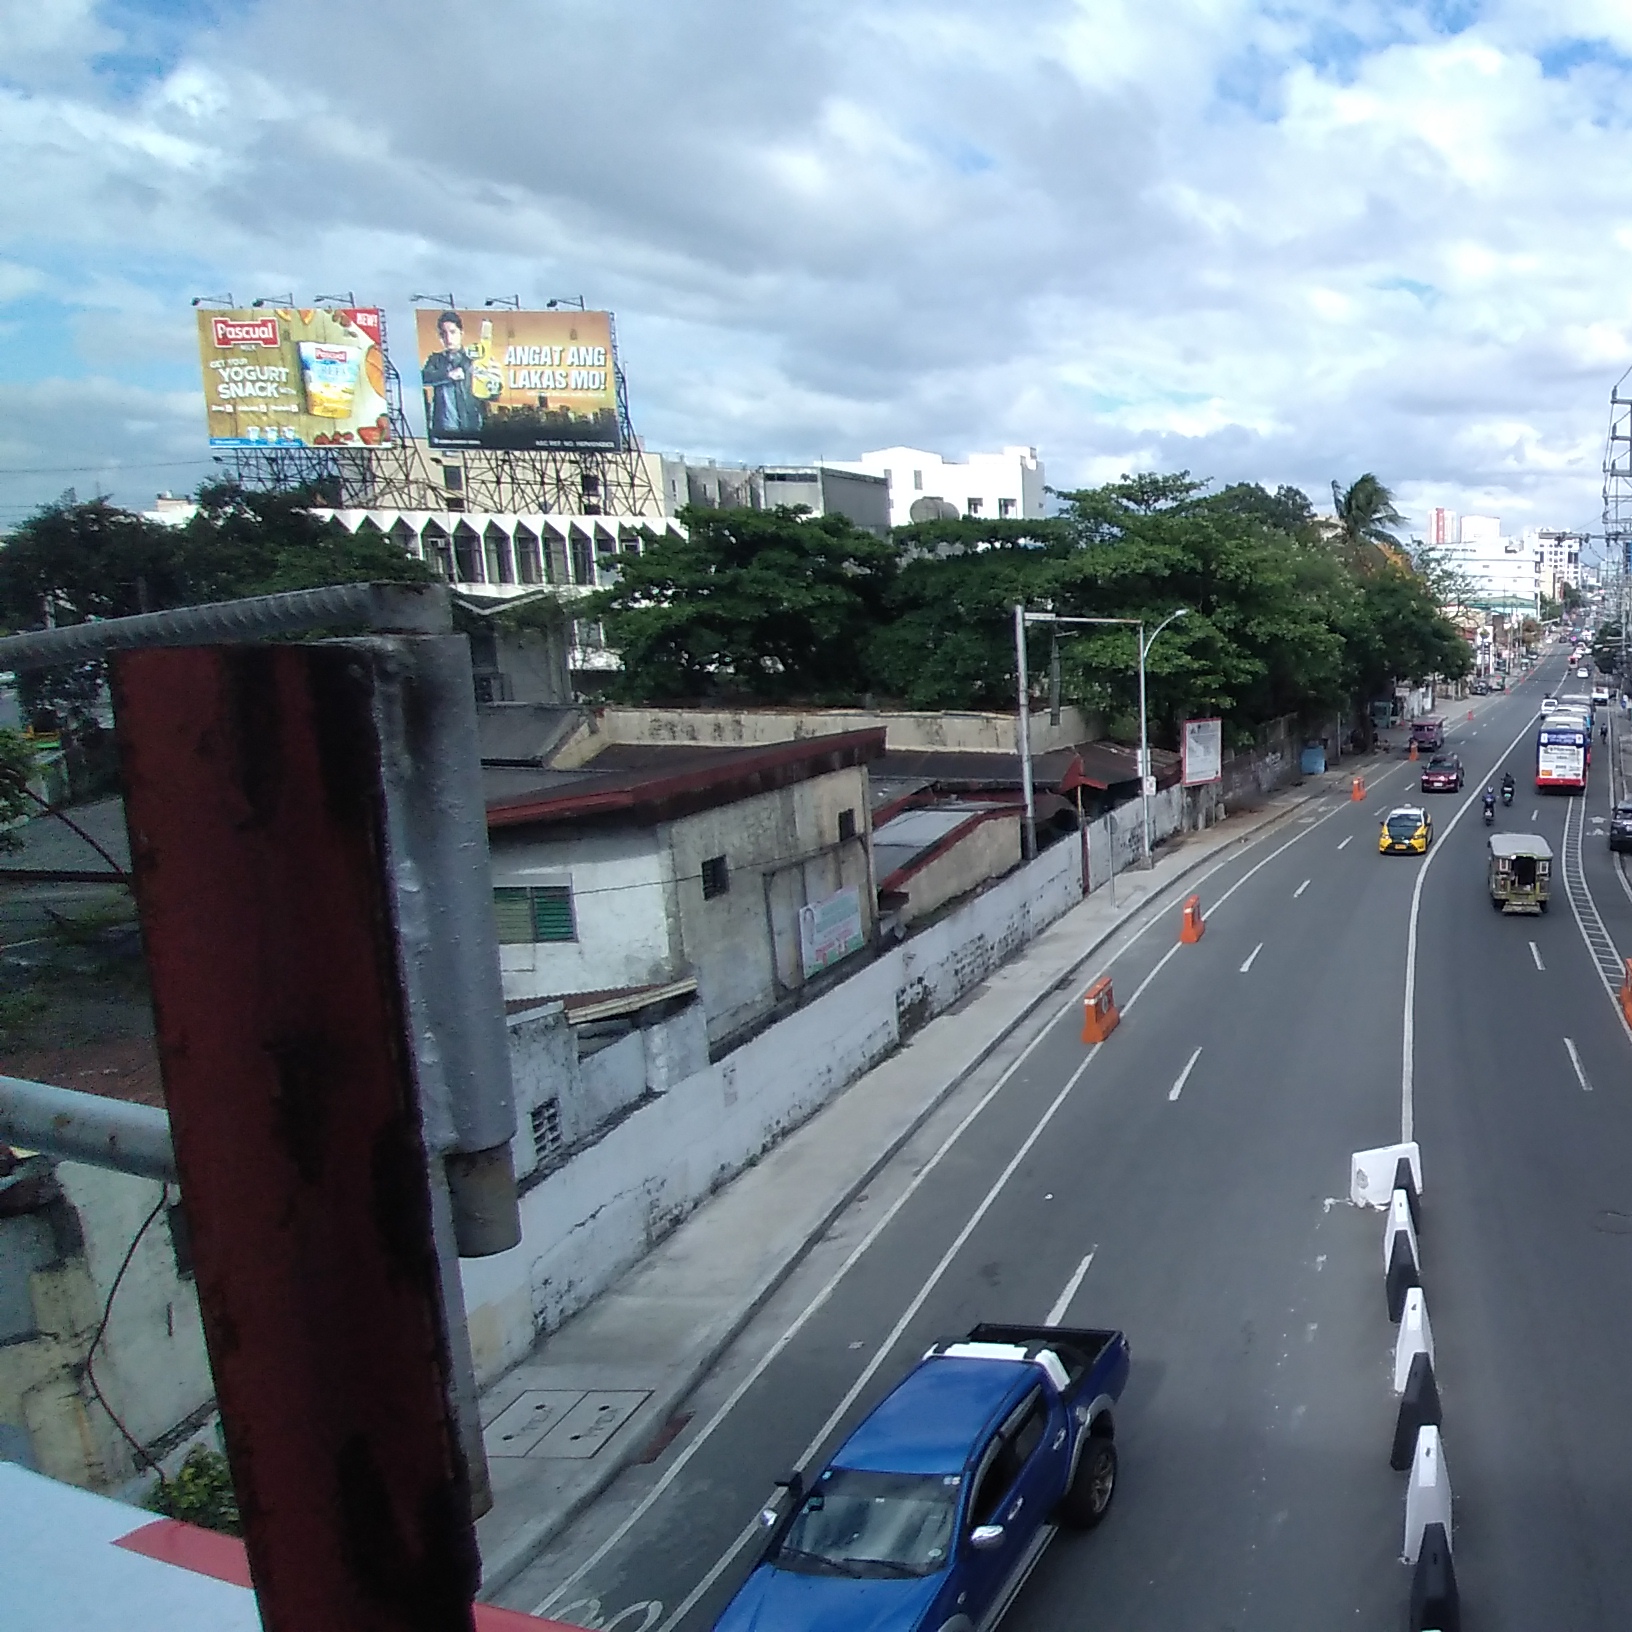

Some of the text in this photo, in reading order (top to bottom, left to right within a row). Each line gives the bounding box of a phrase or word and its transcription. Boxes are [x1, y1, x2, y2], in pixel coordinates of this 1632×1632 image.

[356, 312, 378, 327] NEW!
[216, 322, 274, 339] Pascual
[505, 345, 606, 367] ANGAT ANG
[219, 366, 289, 382] YOGURT
[509, 369, 607, 391] LAKAS MO!
[218, 381, 280, 399] SNACK
